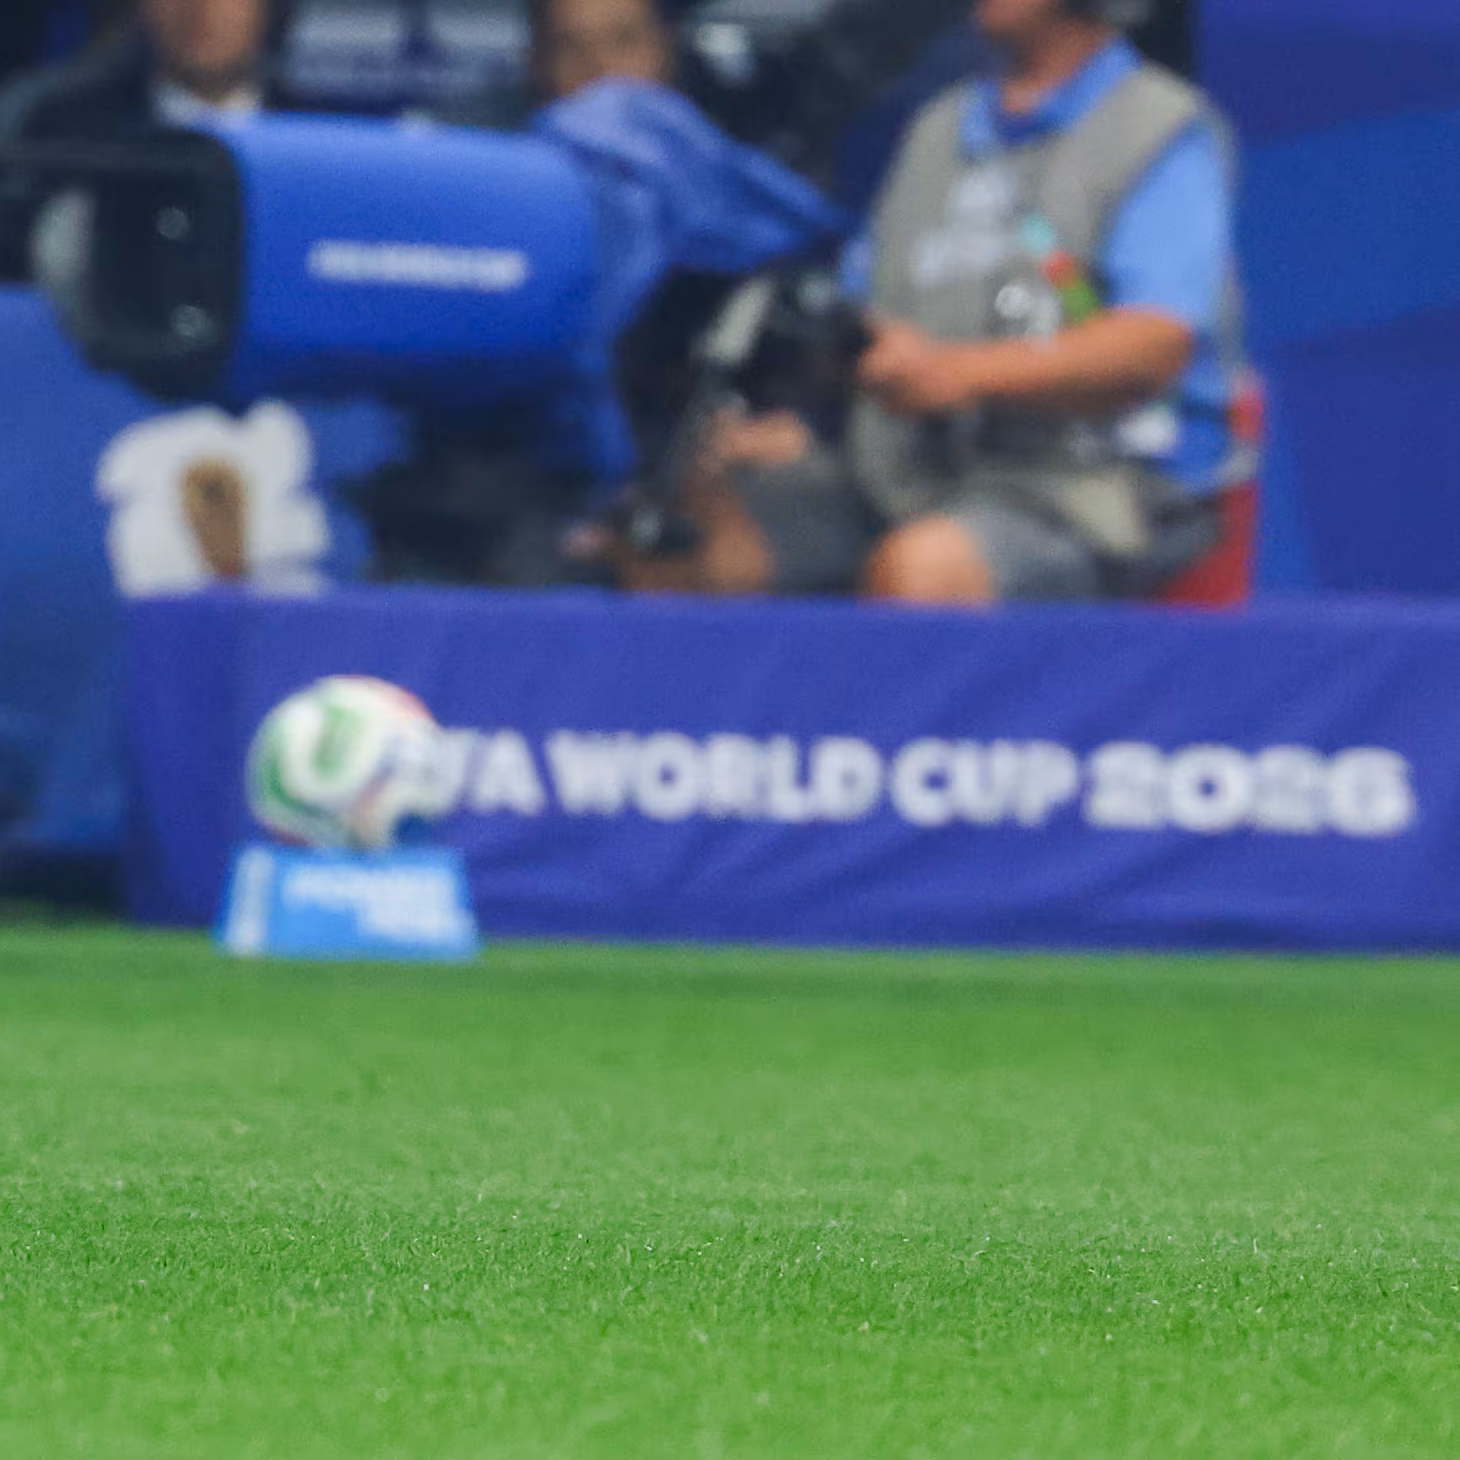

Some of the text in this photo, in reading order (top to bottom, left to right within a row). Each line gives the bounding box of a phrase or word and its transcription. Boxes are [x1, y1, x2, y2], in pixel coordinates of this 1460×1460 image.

[546, 729, 882, 822] WORLD
[890, 735, 1079, 828] CUP
[1082, 740, 1414, 837] 2026
